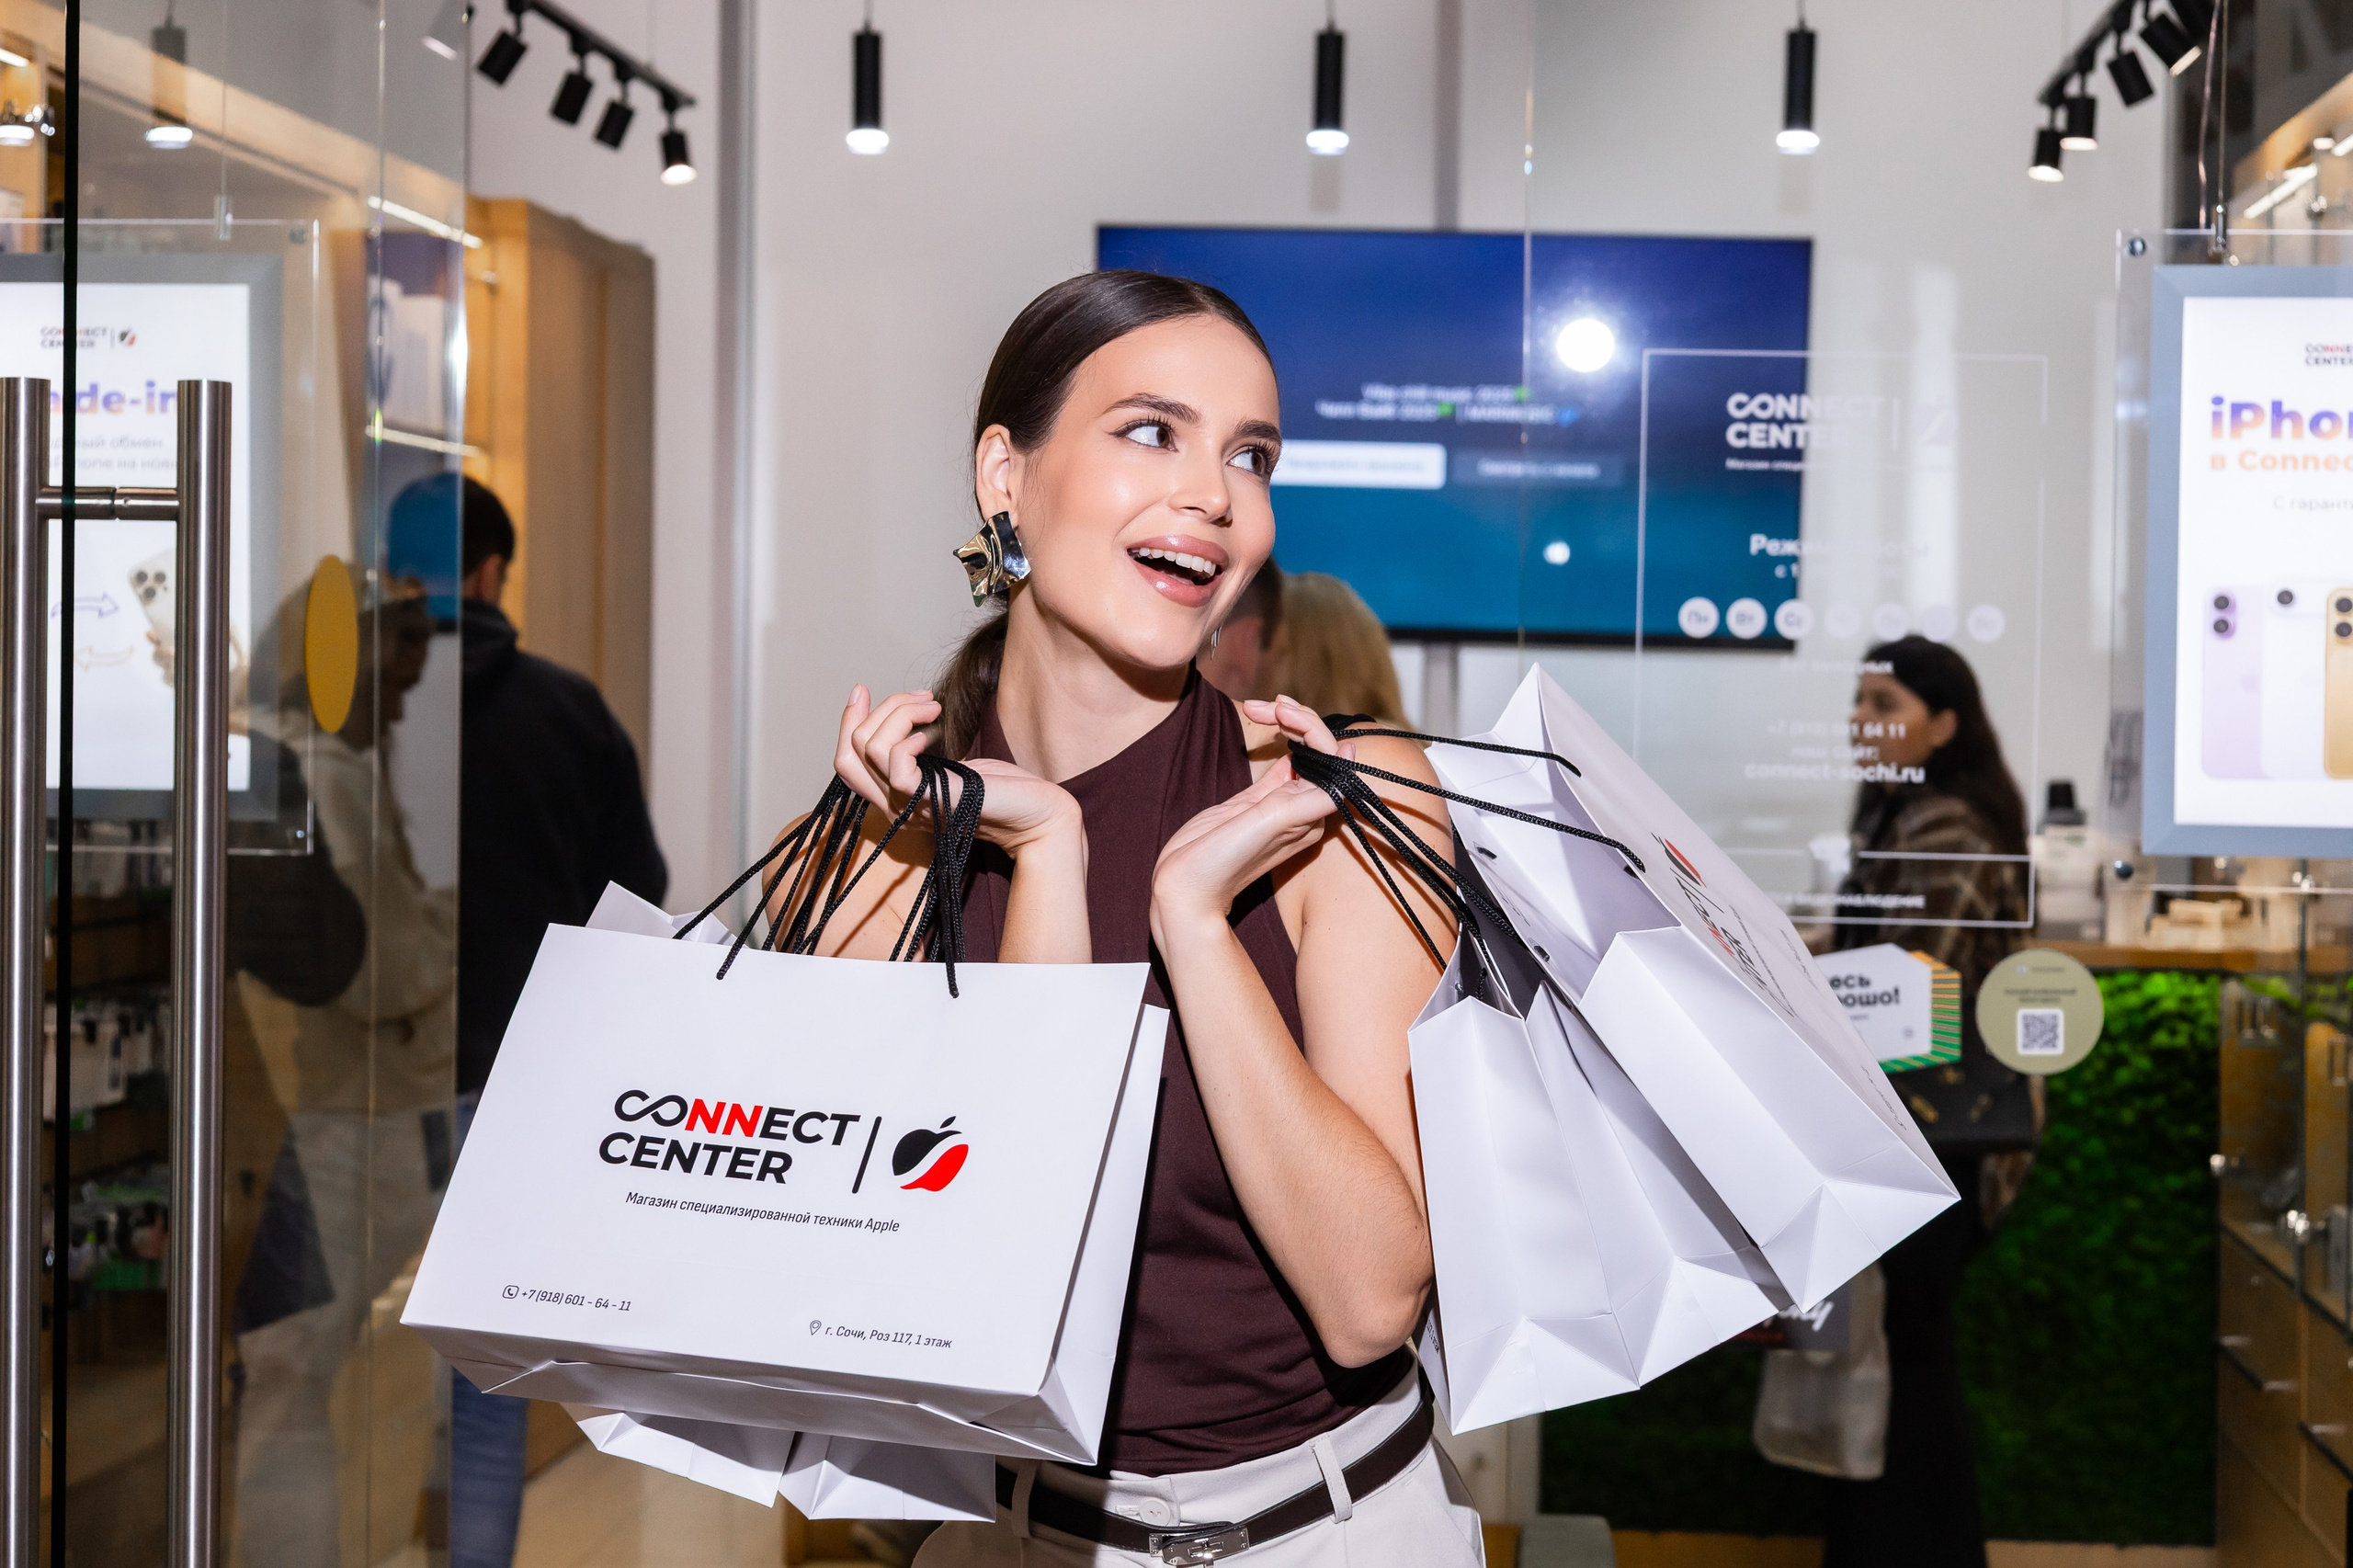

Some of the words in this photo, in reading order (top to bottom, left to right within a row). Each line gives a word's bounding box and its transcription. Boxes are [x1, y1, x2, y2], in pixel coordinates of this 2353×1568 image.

[2211, 395, 2353, 440] iPho
[2211, 453, 2226, 471] в
[614, 1089, 861, 1146] CONNECT
[598, 1131, 793, 1185] CENTER
[625, 1191, 677, 1210] Магазин
[679, 1199, 811, 1224] специализированной
[813, 1215, 863, 1230] техники
[864, 1218, 900, 1233] Apple
[564, 1293, 585, 1307] 601
[595, 1297, 609, 1309] 64
[619, 1301, 631, 1312] 11
[824, 1326, 833, 1335] г.
[836, 1325, 867, 1341] Сочи,
[870, 1329, 891, 1342] Роз
[892, 1332, 913, 1346] 117,
[915, 1335, 922, 1346] 1
[924, 1336, 953, 1348] этаж
